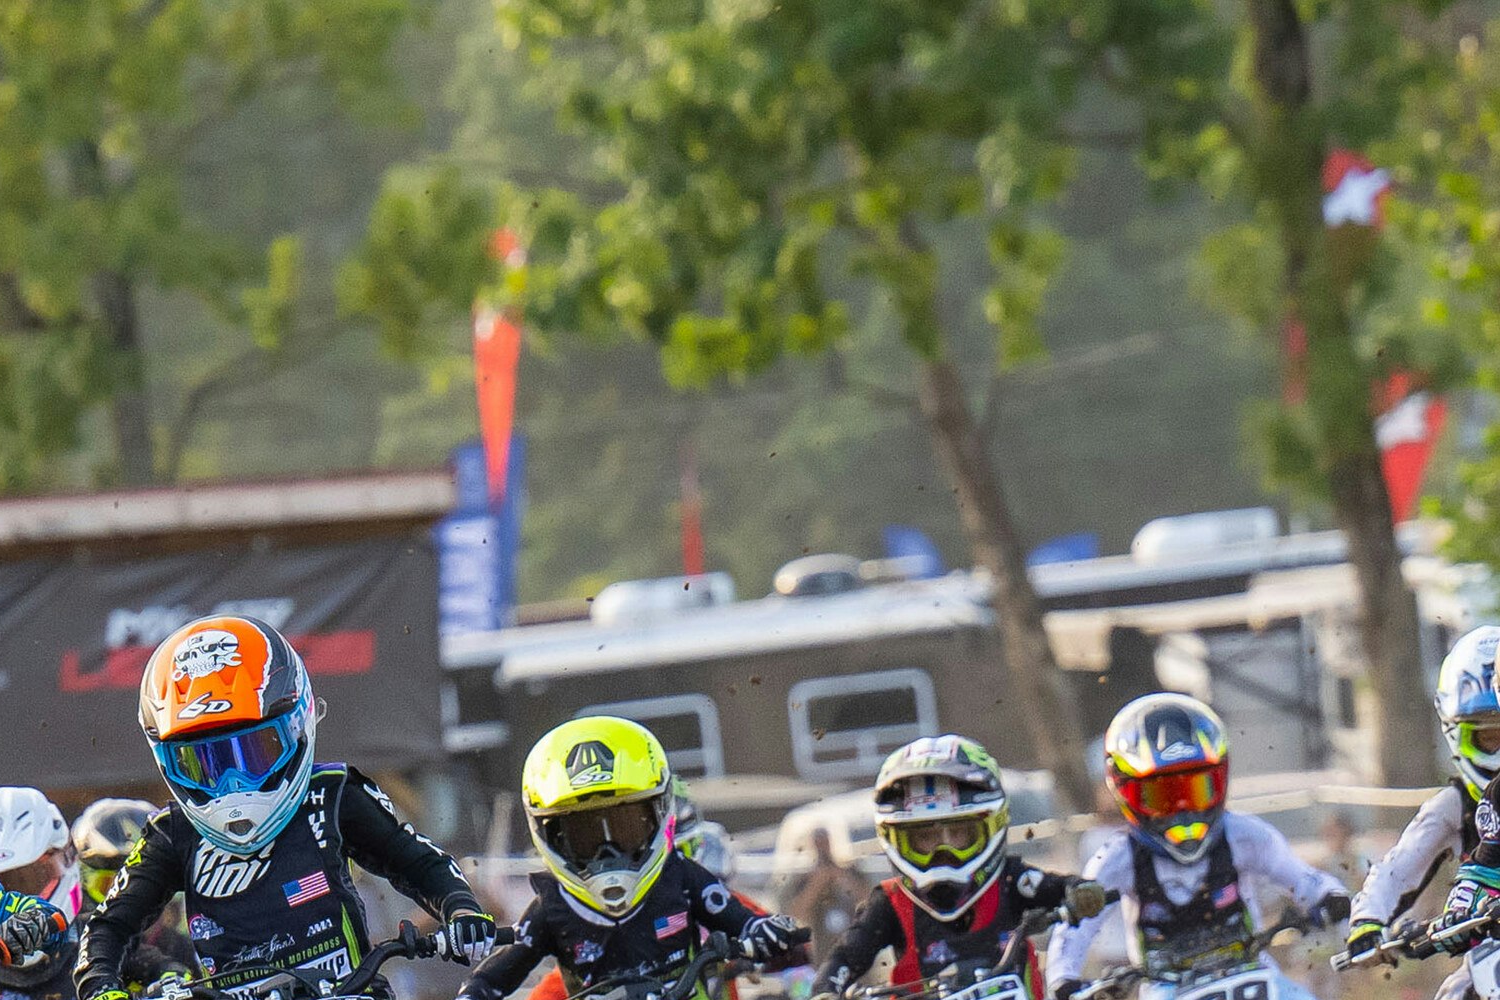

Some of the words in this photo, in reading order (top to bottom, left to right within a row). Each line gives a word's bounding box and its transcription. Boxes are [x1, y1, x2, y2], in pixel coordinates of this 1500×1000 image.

[178, 692, 234, 720] 6D
[306, 918, 333, 938] AMA
[288, 936, 341, 966] MOTOCROSS
